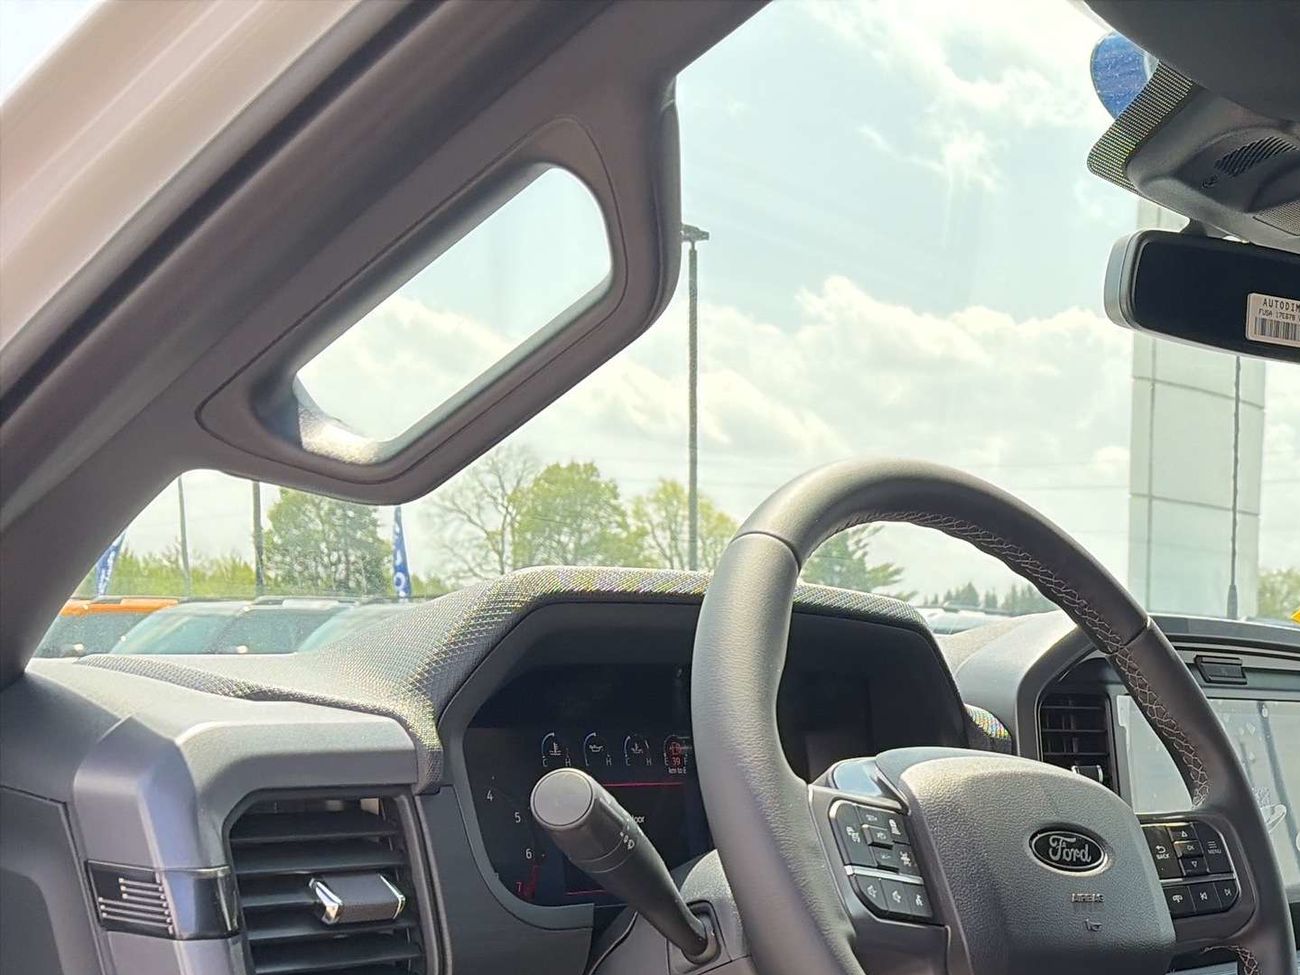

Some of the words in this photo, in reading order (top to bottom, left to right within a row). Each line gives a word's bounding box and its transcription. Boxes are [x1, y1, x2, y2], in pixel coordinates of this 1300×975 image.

[1262, 298, 1300, 313] AUTODIM
[486, 790, 493, 801] 4
[514, 812, 521, 823] 5
[525, 849, 532, 860] 6
[1049, 835, 1092, 863] Ford
[516, 882, 522, 893] 7
